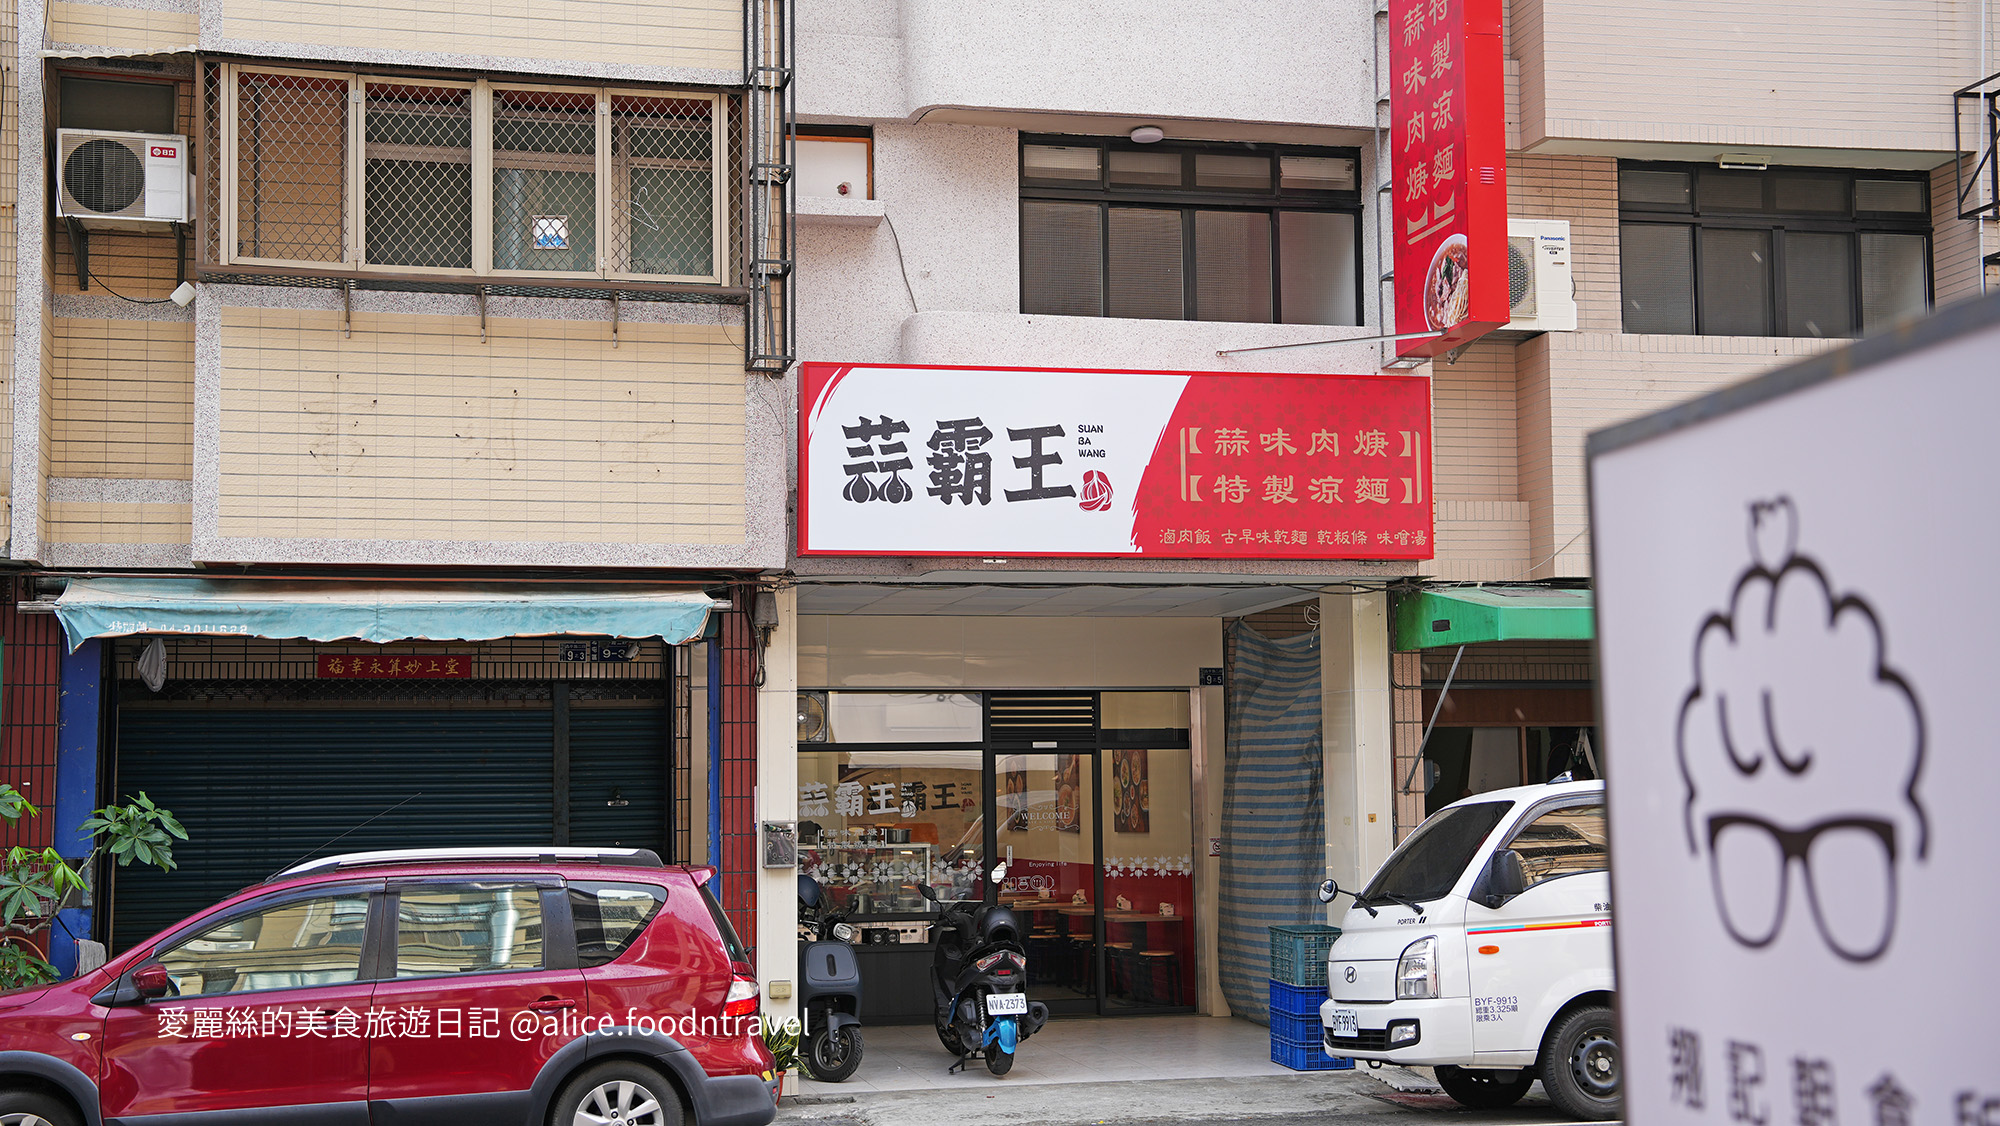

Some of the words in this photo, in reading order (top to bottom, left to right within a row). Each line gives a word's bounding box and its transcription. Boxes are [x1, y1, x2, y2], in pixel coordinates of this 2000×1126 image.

[1077, 424, 1104, 433] SUAN
[1077, 437, 1092, 446] BA
[1078, 449, 1106, 458] WANG
[841, 414, 1077, 506] 蒜霸王
[1159, 528, 1212, 545] 滷肉飯
[1221, 528, 1308, 546] 古早味乾麵
[1020, 811, 1071, 821] WELCOME
[1028, 861, 1055, 869] Enjoying
[1397, 917, 1416, 925] PORTER
[1474, 995, 1518, 1007] BYF-9913
[1332, 1014, 1357, 1032] BYF-9913
